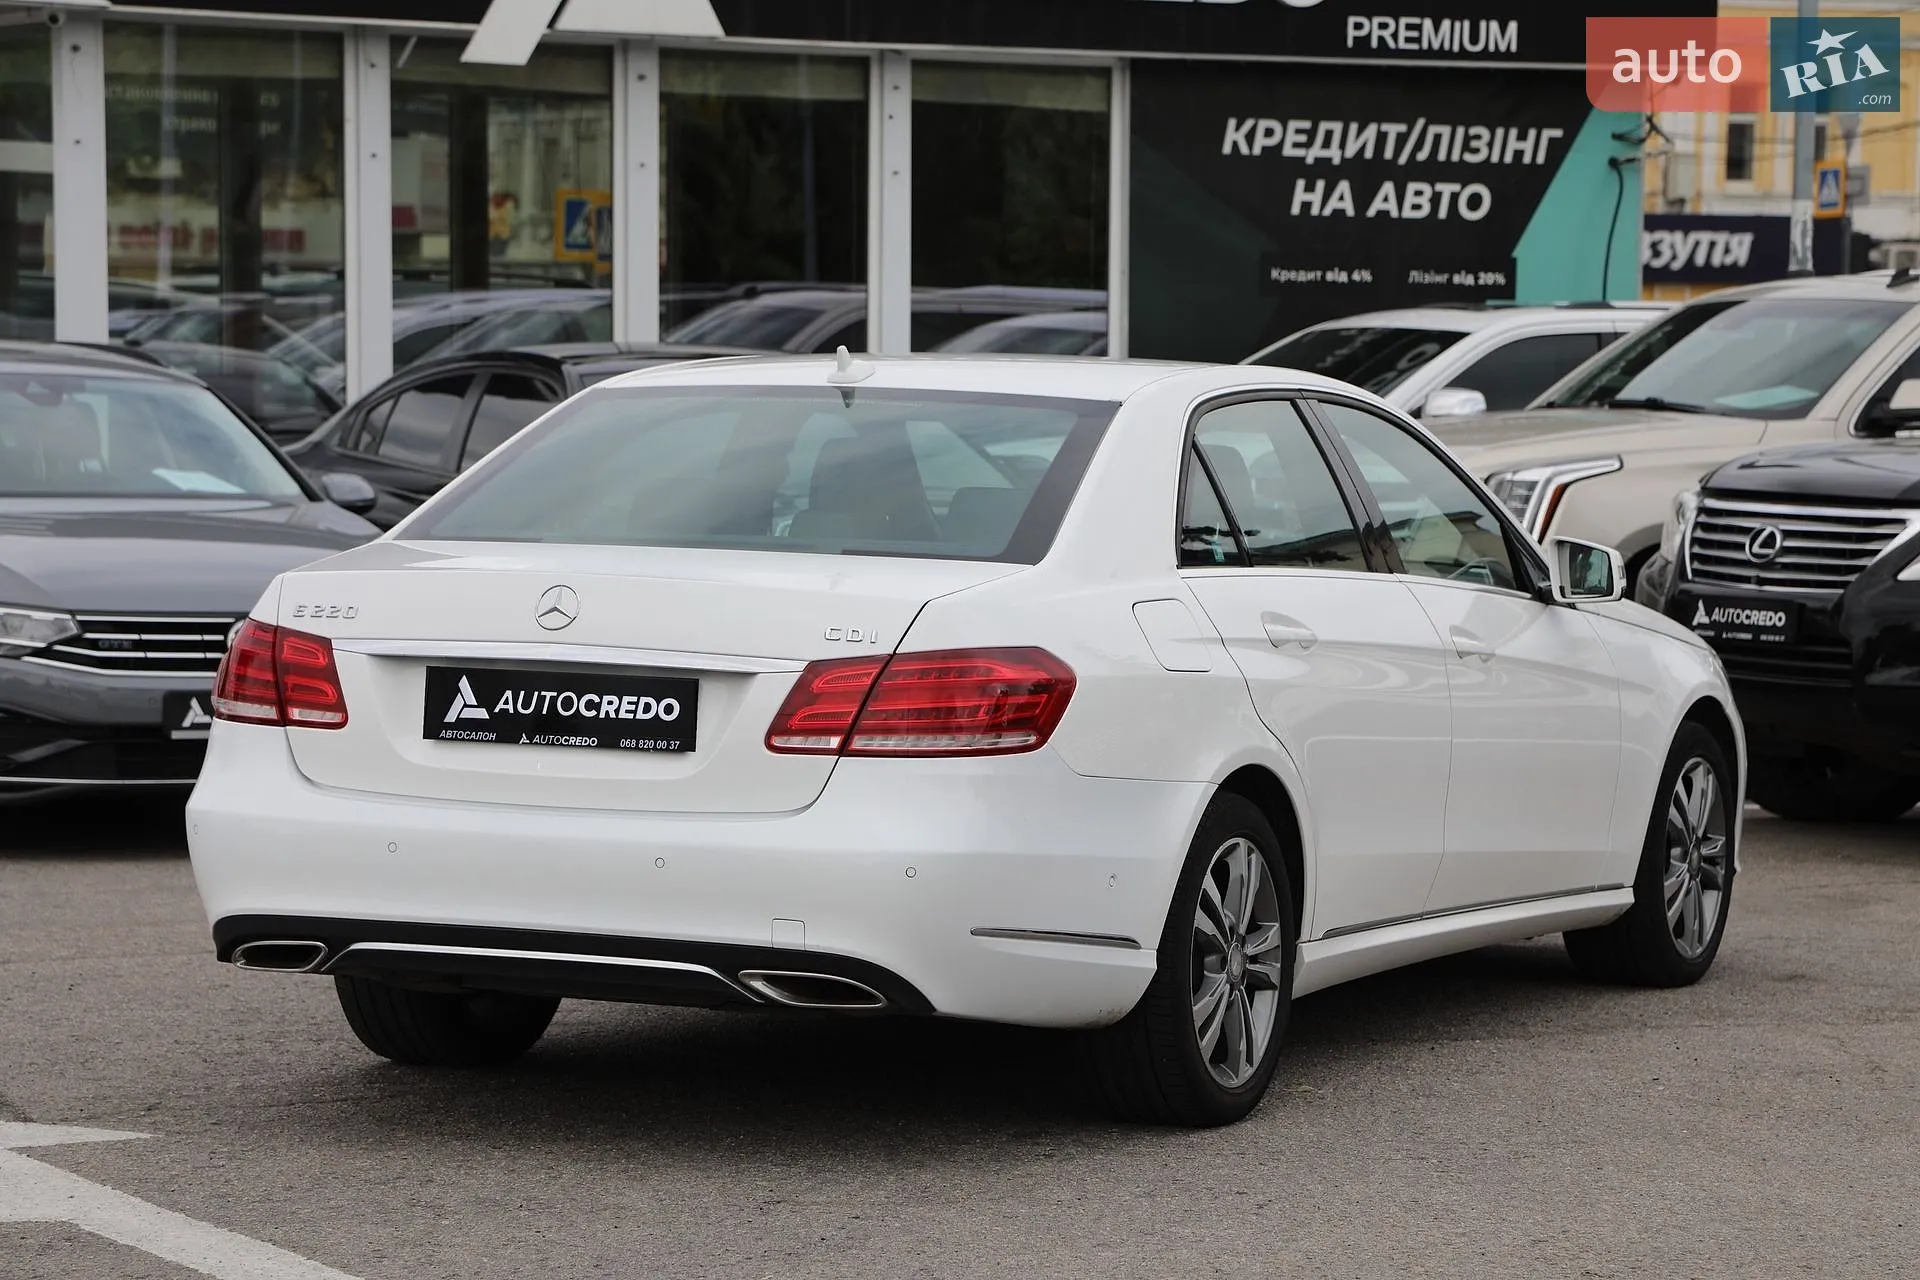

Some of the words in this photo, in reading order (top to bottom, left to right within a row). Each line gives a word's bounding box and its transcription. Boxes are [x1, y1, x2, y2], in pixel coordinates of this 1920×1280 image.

[1346, 15, 1519, 53] PREMIUM
[1221, 117, 1563, 167] КРЕДИТ/ЛІЗІНГ
[1290, 180, 1357, 219] НА
[1365, 181, 1493, 222] АВТО
[1270, 267, 1323, 284] Кредит
[1325, 268, 1349, 284] від
[1351, 269, 1373, 283] 4%
[1408, 270, 1450, 286] Лізінг
[1452, 271, 1476, 287] від
[1477, 272, 1507, 286] 20%
[293, 603, 308, 618] E
[310, 603, 359, 620] 220
[1711, 606, 1786, 627] AUTOCREDO
[824, 626, 879, 644] CDI
[493, 690, 680, 722] AUTOCREDO
[439, 729, 497, 742] АВТОСАЛОН
[532, 734, 598, 747] AUTOCREDO
[619, 738, 637, 749] 068
[638, 739, 655, 750] 820
[656, 740, 668, 750] 00
[669, 740, 680, 751] 37
